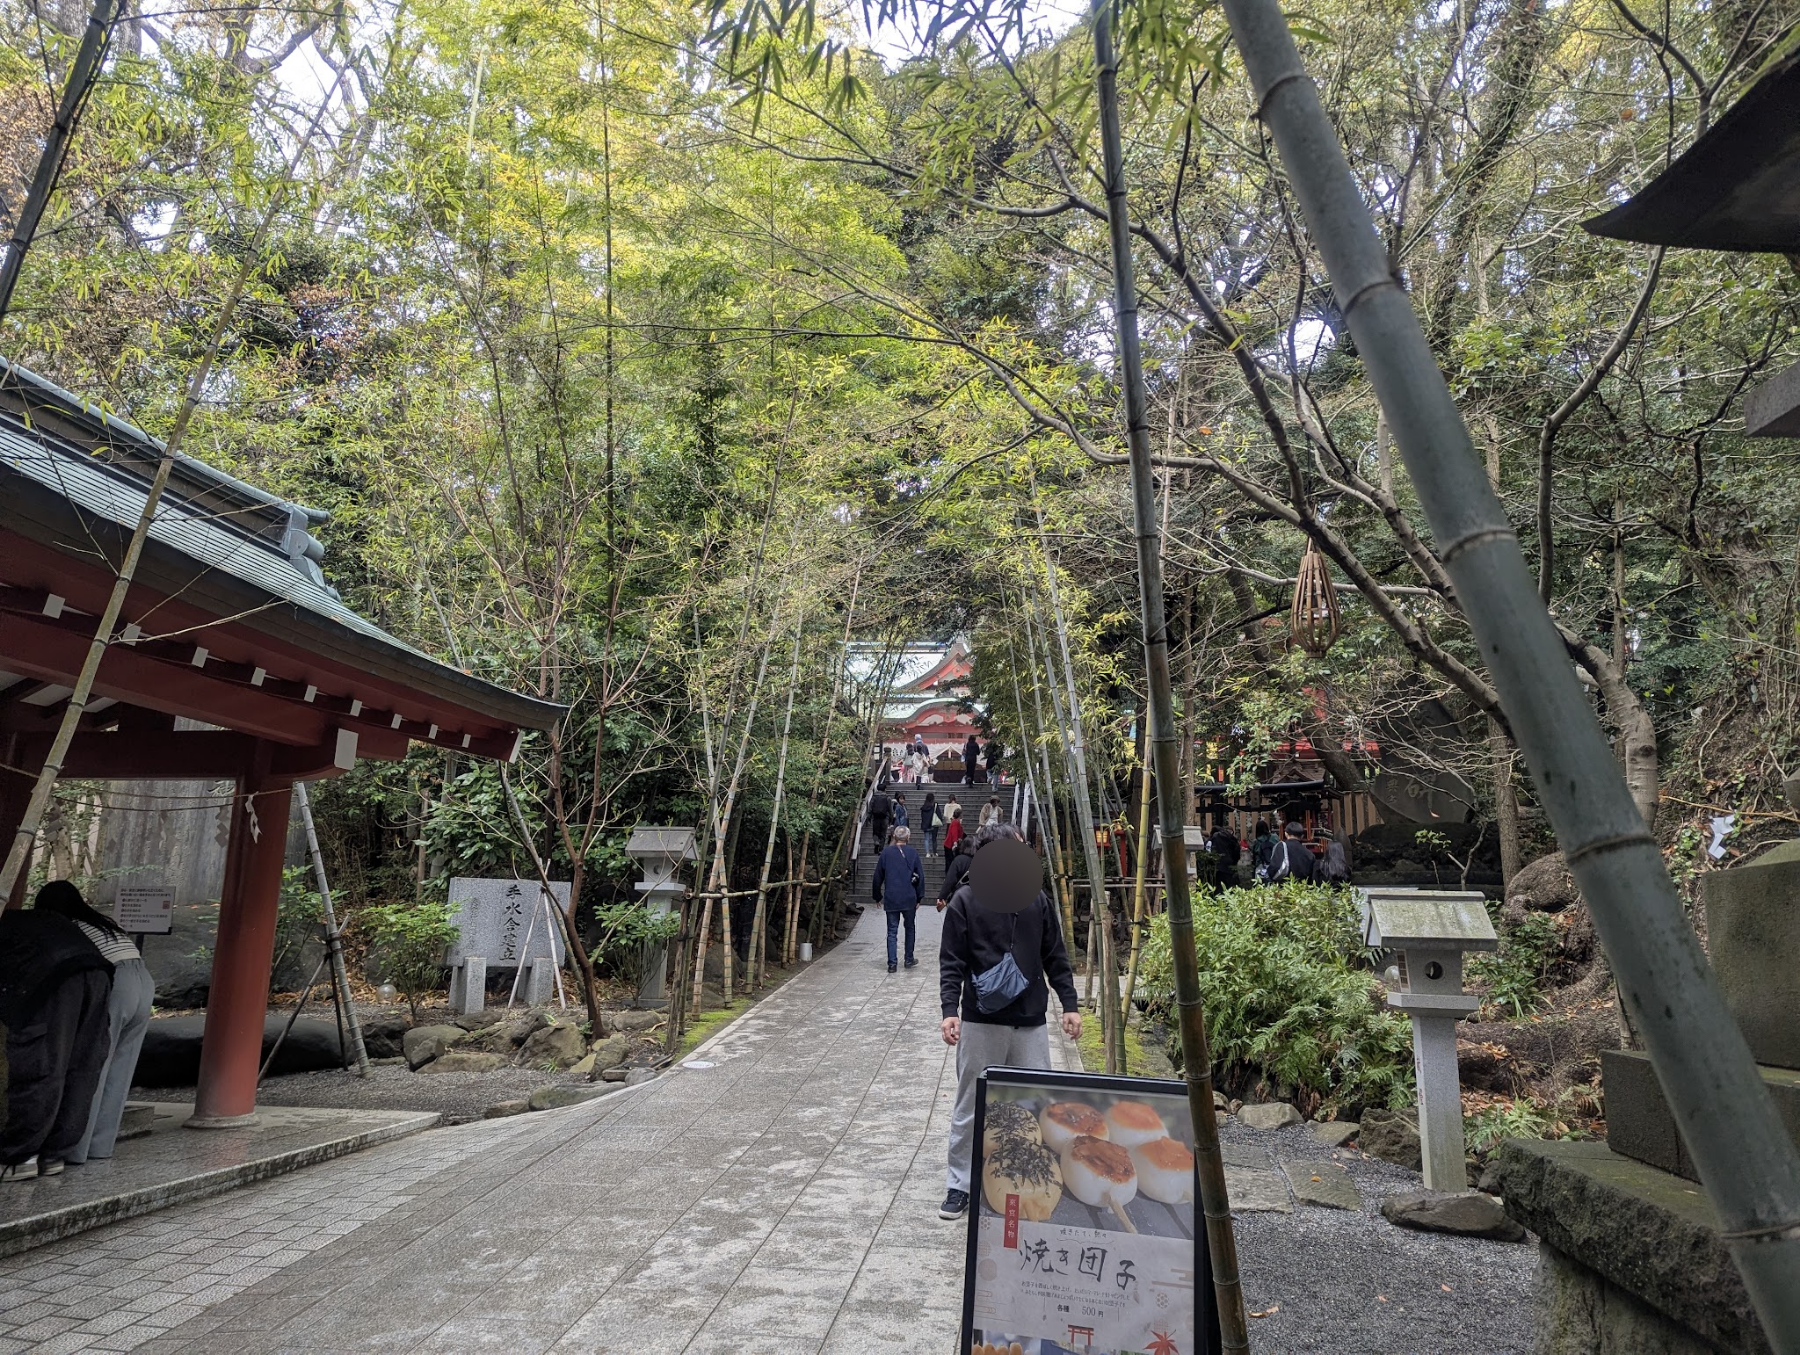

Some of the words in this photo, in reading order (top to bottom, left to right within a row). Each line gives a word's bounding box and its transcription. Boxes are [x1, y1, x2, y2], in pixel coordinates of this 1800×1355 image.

[1018, 1238, 1136, 1290] 焼き団子
[1057, 1304, 1070, 1313] 各種
